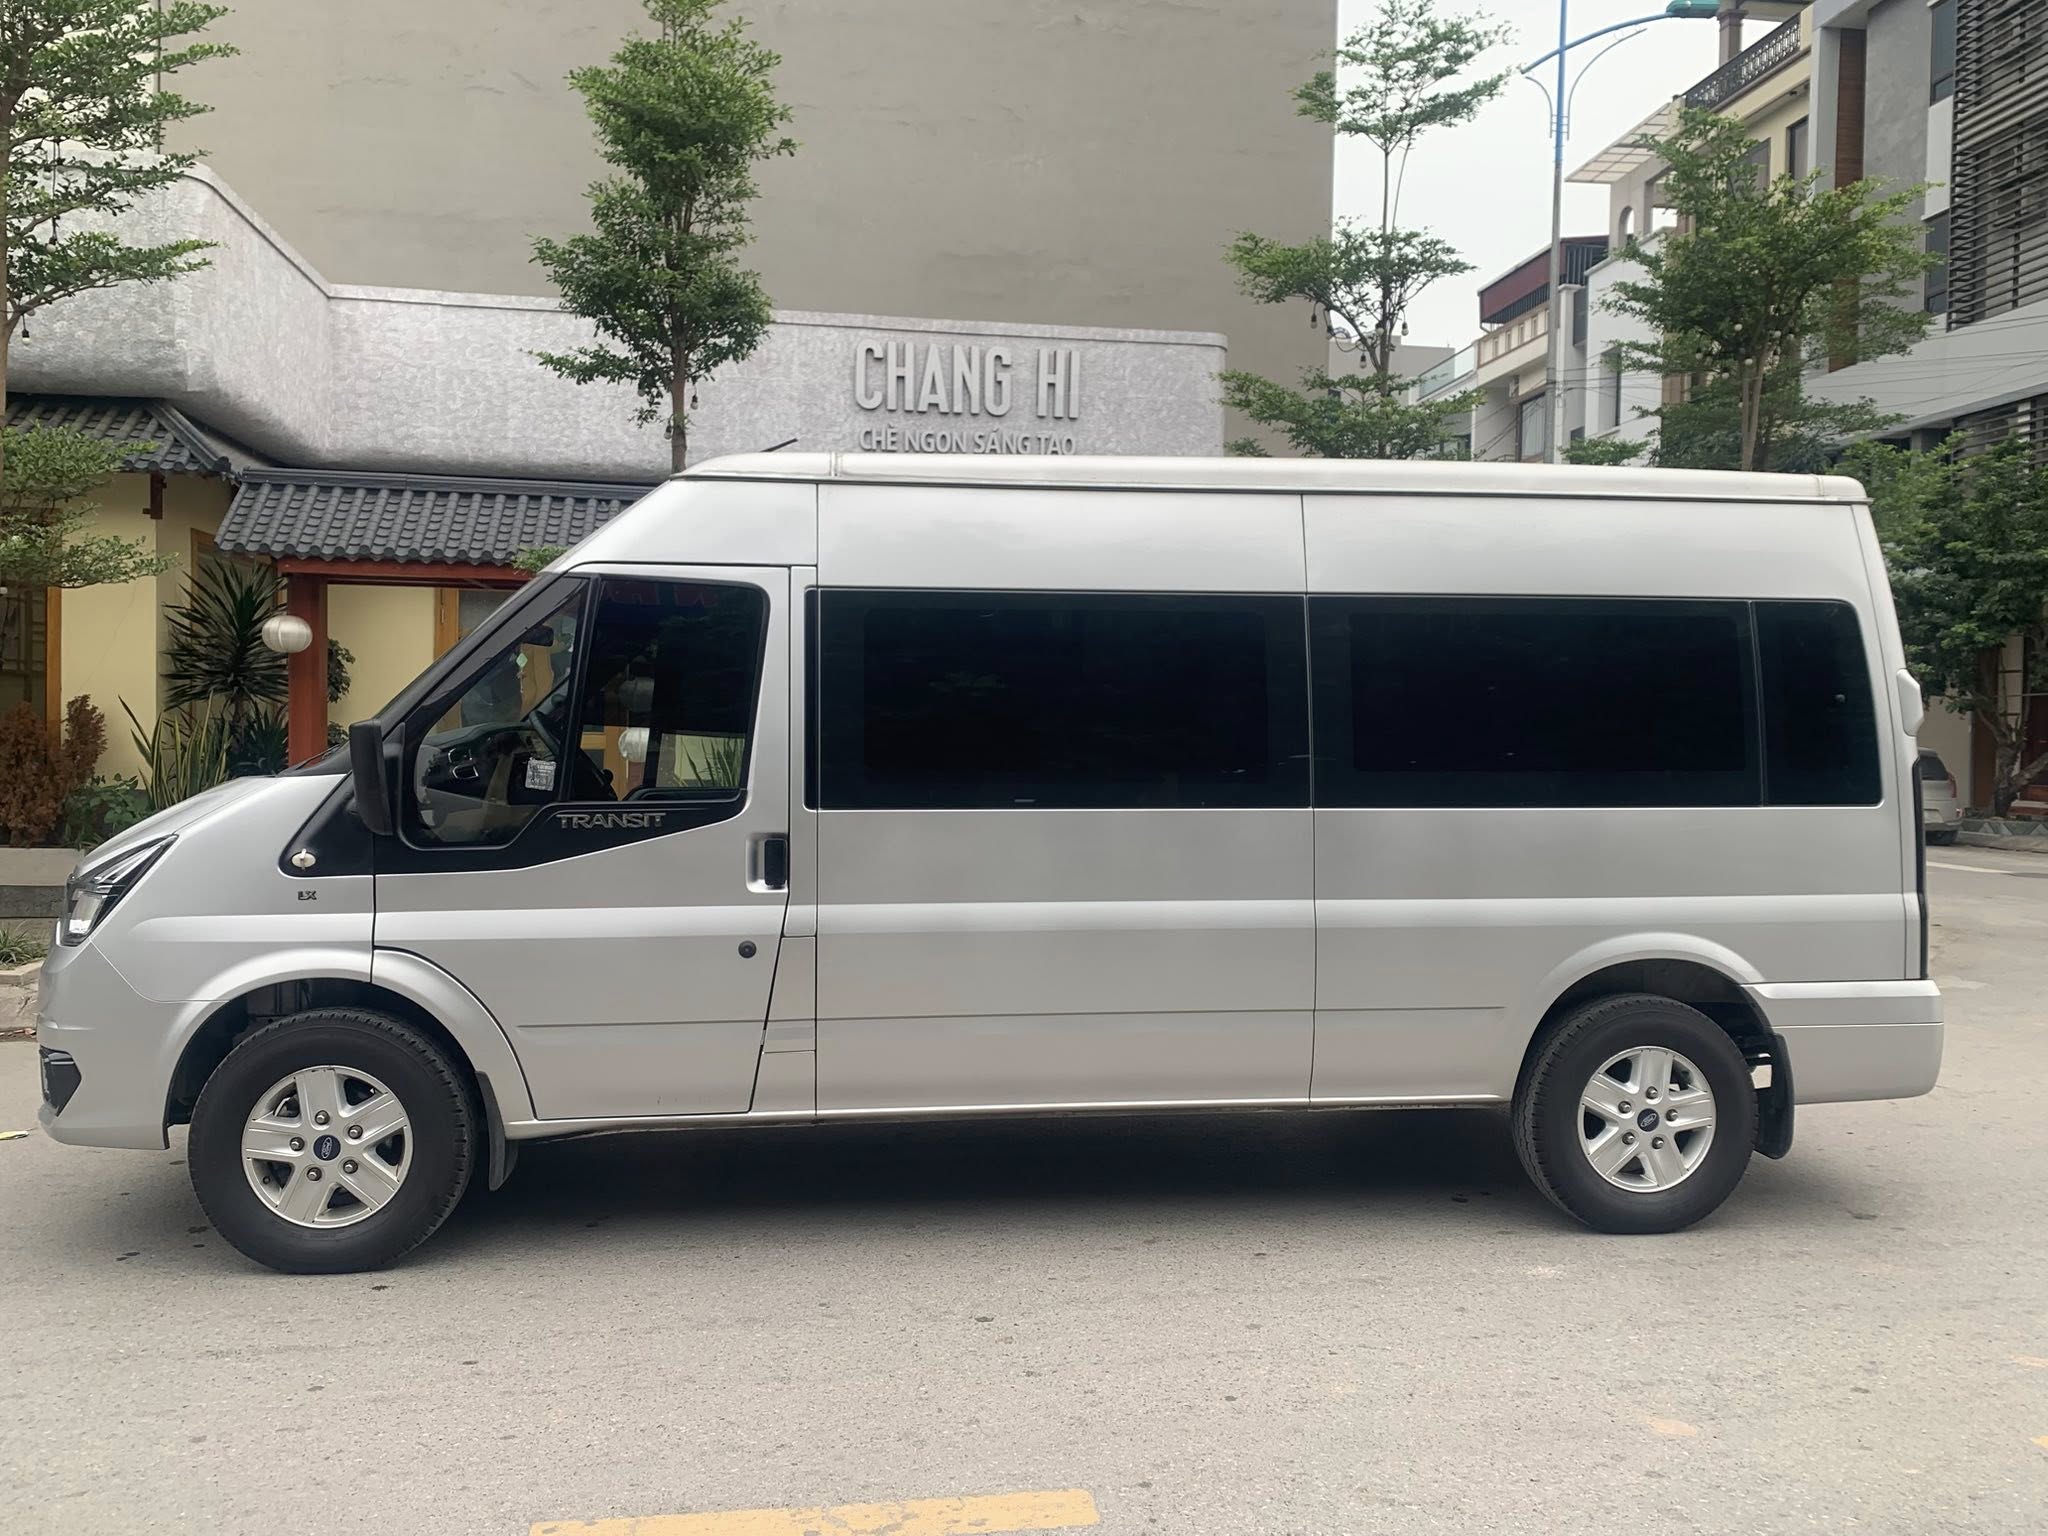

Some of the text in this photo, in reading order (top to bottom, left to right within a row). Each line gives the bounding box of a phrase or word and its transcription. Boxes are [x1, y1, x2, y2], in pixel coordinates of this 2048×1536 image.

[856, 339, 1080, 418] CHANG HI
[859, 424, 897, 452] CHÈ
[904, 430, 966, 453] NGON
[973, 428, 1031, 455] SÁNG
[556, 813, 666, 829] TRANSIT
